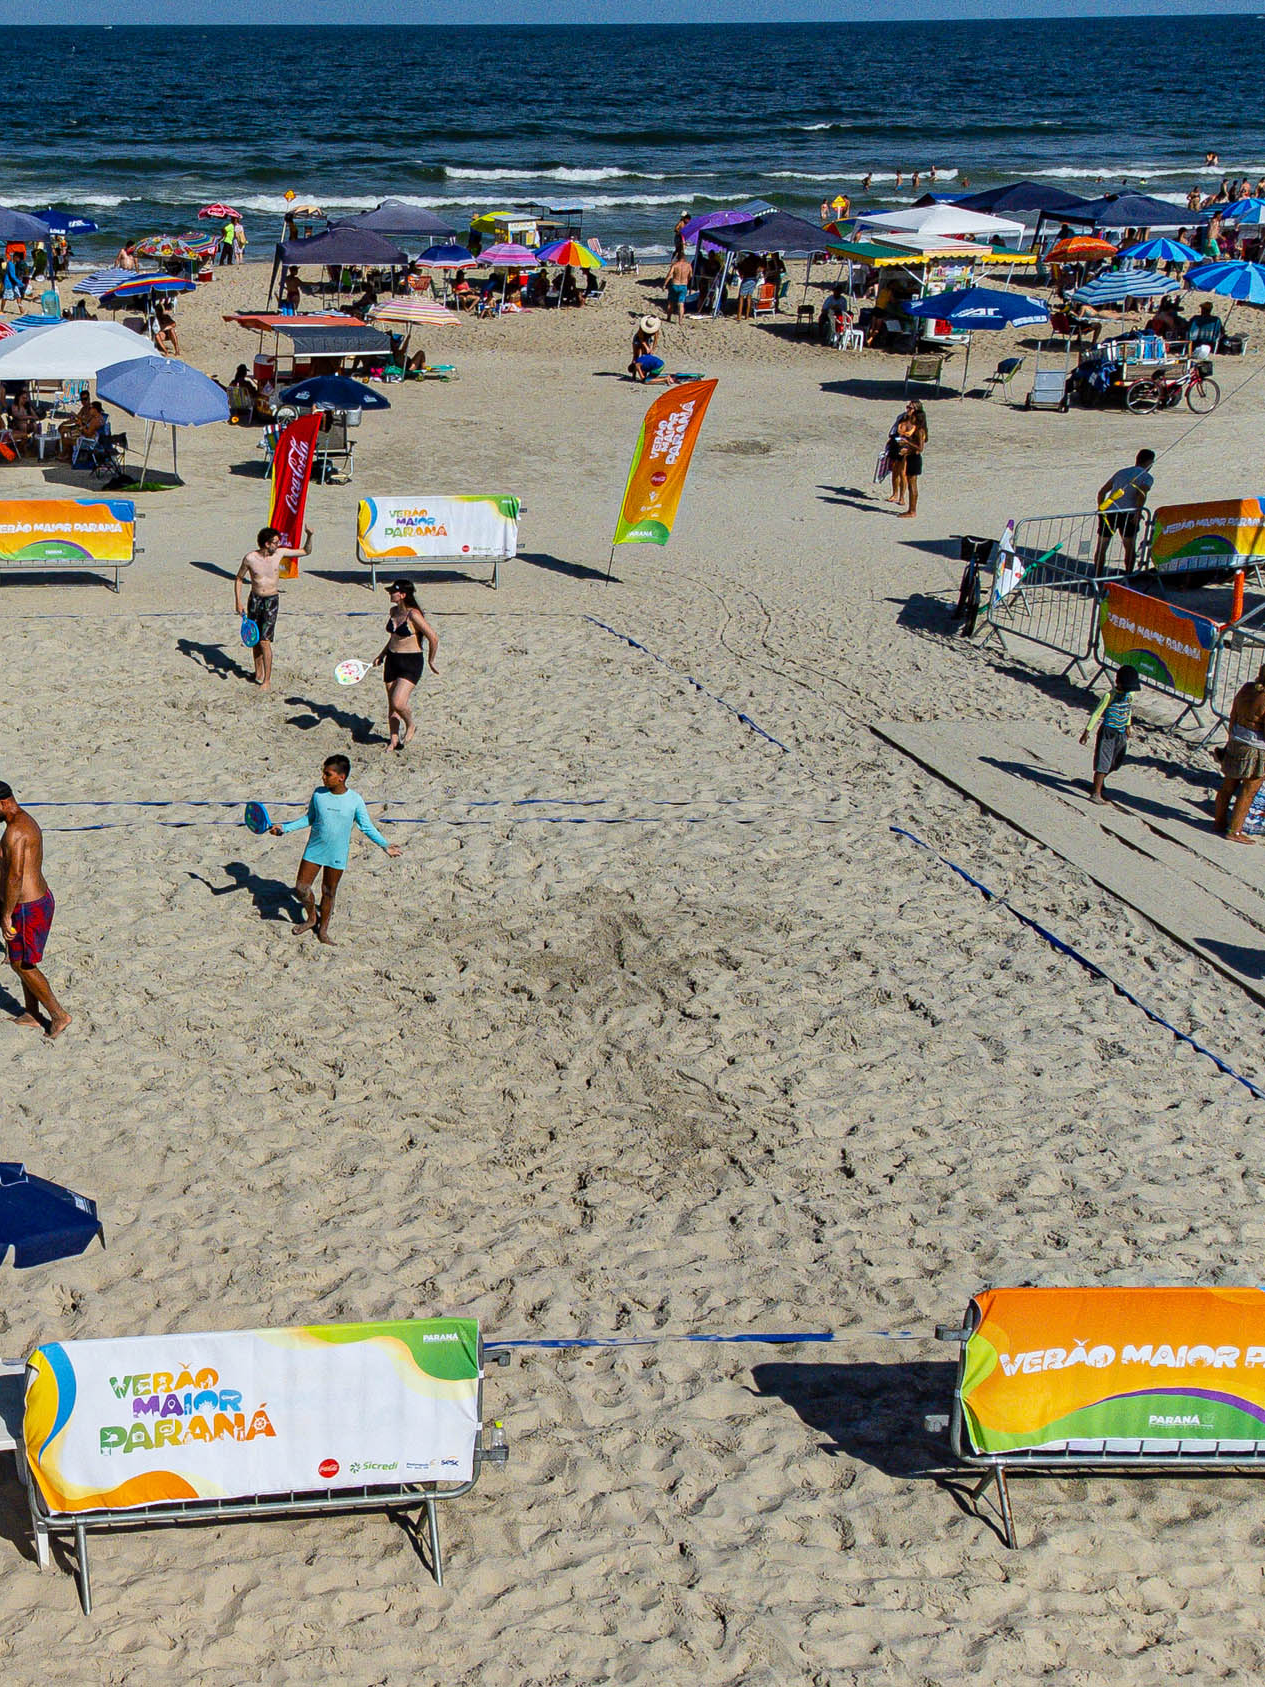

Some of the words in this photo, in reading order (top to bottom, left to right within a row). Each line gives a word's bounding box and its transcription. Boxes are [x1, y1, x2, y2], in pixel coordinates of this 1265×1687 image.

[649, 420, 668, 459] VERÃO
[661, 412, 681, 452] MAIOR
[665, 400, 696, 465] PARANÁ
[389, 507, 428, 518] VERÃO
[396, 517, 436, 527] MAIOR
[33, 523, 73, 533] MAIOR
[73, 522, 123, 533] PARANÁ
[385, 523, 448, 538] PARANÁ
[422, 1333, 459, 1343] PARANÁ
[999, 1338, 1116, 1377] VERÃO
[1120, 1344, 1241, 1369] MAIOR
[109, 1363, 220, 1399] VERÃO
[132, 1389, 243, 1420] MAIOR
[99, 1403, 277, 1457] PARANÁ
[1149, 1414, 1200, 1425] PARANÁ
[362, 1461, 400, 1471] Sicredi
